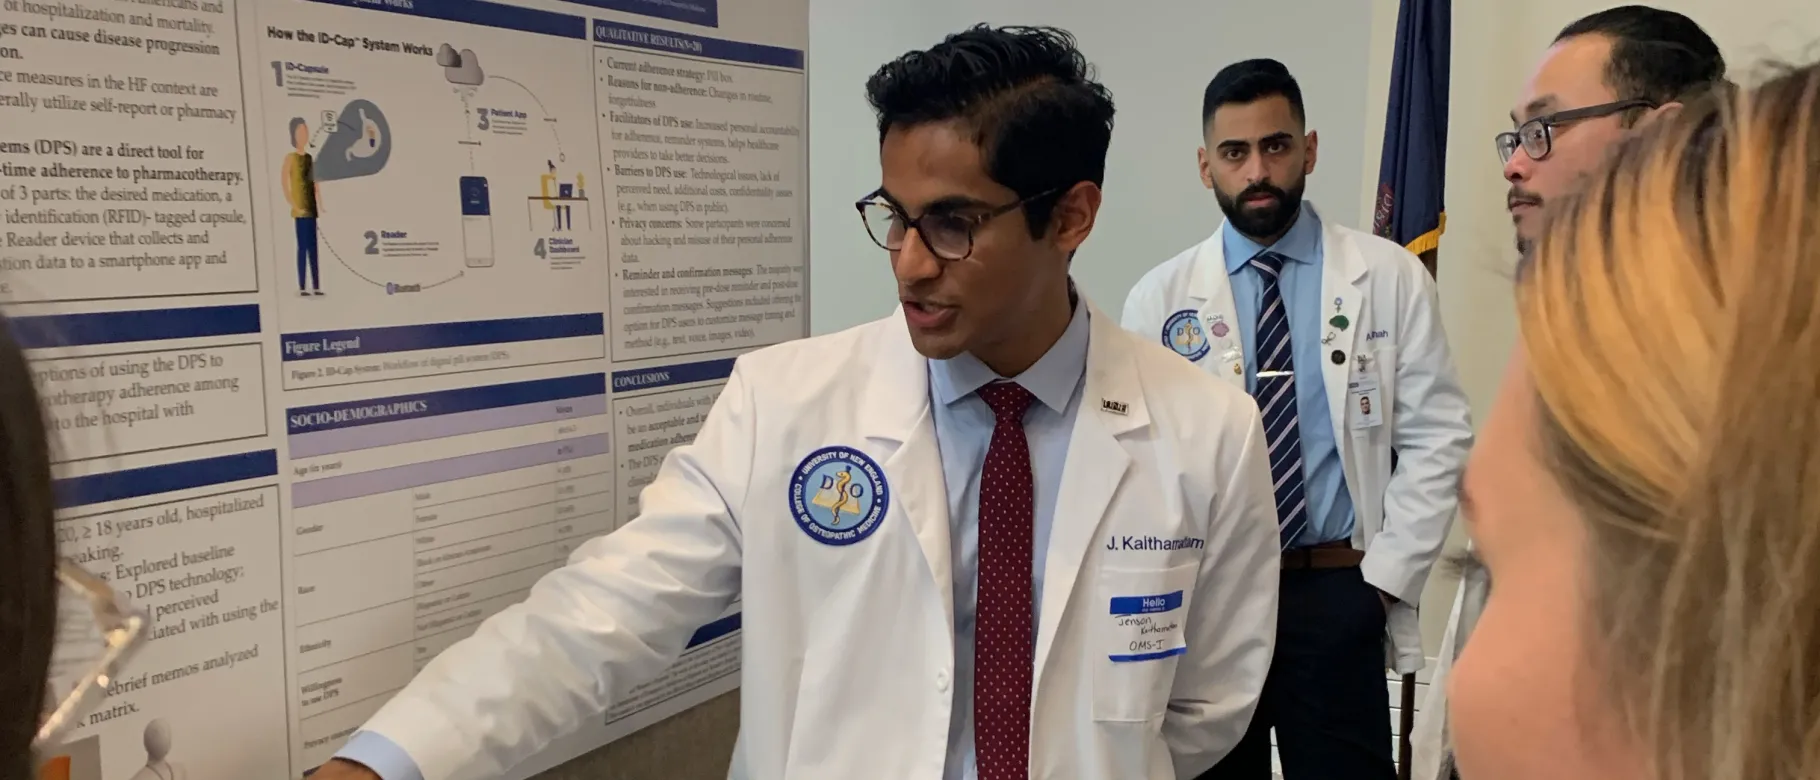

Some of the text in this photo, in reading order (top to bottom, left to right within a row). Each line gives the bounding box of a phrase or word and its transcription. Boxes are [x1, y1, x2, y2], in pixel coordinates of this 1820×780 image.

[22, 0, 125, 24] hospitalization
[129, 13, 154, 28] and
[21, 25, 220, 55] can cause disease progression
[267, 26, 294, 41] How
[297, 29, 316, 43] the
[362, 37, 401, 53] System
[401, 42, 434, 57] Works
[16, 72, 219, 97] measures in the HF context are
[270, 61, 285, 88] 1
[42, 95, 87, 111] utilize
[90, 97, 157, 119] self-report
[160, 105, 174, 116] or
[177, 101, 237, 124] pharmacy
[476, 107, 491, 131] 3
[34, 138, 78, 157] (DPS)
[82, 145, 103, 157] are
[106, 146, 114, 157] a
[117, 142, 154, 158] direct
[157, 145, 182, 160] tool
[186, 145, 205, 160] for
[40, 161, 113, 179] adherence
[116, 166, 130, 179] to
[132, 165, 244, 186] pharmacotherapy.
[0, 184, 16, 201] of
[19, 185, 29, 201] 3
[76, 186, 98, 201] the
[100, 186, 149, 202] desired
[151, 187, 223, 204] medication,
[225, 191, 233, 202] a
[5, 208, 100, 224] identification
[154, 209, 197, 228] tagged
[199, 209, 246, 228] capsule,
[6, 230, 210, 247] Reader device that collects and
[364, 230, 380, 256] 2
[534, 238, 548, 261] 4
[36, 250, 228, 272] data to a smartphone app and
[285, 336, 361, 357] Figure Legend
[90, 353, 224, 379] of using the DPS to
[119, 377, 240, 400] adherence among
[74, 410, 98, 428] the
[101, 403, 159, 428] hospital
[162, 399, 195, 418] with
[290, 399, 428, 429] SOCIO-DEMOGRAPHICS
[801, 451, 884, 496] UNIVERSITY OF NEW ENGLAND
[820, 473, 864, 498] D O
[96, 519, 113, 537] 18
[116, 517, 154, 539] years
[156, 507, 183, 526] old,
[186, 493, 265, 521] hospitalized
[793, 483, 882, 540] COLLEGE OF OSTEOPATHIC MEDICINE
[1106, 535, 1119, 551] J.
[115, 545, 236, 581] Explored baseline
[135, 579, 166, 600] DPS
[156, 588, 220, 622] perceived
[189, 611, 220, 630] with
[222, 605, 258, 621] using
[259, 598, 279, 613] the
[1142, 598, 1166, 608] Hello
[1115, 613, 1152, 627] Jenson
[1129, 639, 1165, 651] OMS-I
[151, 662, 201, 686] memos
[202, 643, 260, 670] analyzed
[90, 701, 141, 725] matrix.
